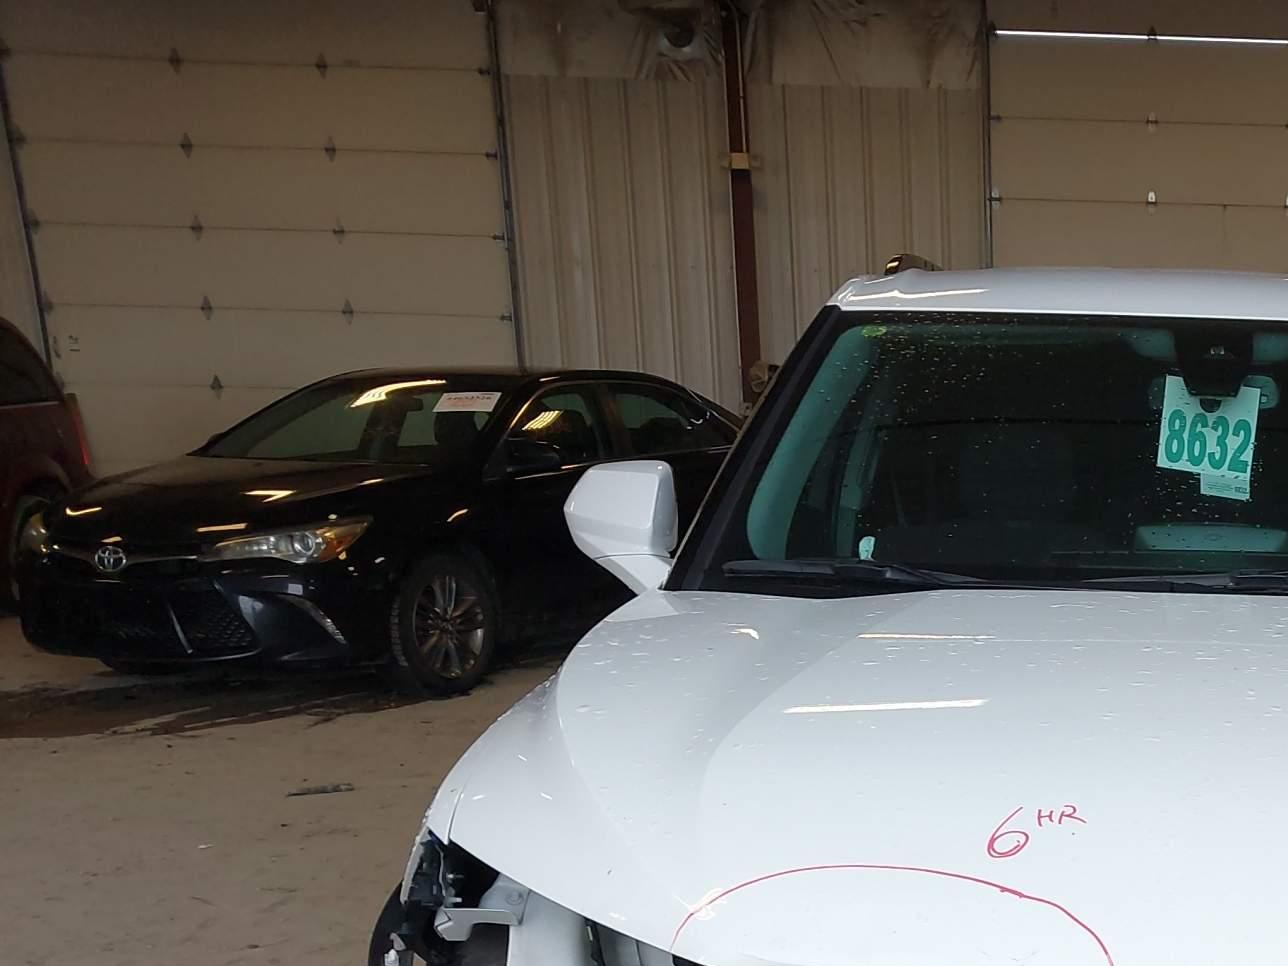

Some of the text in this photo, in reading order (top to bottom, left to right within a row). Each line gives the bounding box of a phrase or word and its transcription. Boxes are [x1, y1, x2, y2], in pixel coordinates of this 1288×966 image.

[1164, 408, 1252, 474] 8632
[987, 804, 1087, 859] 6 HR
